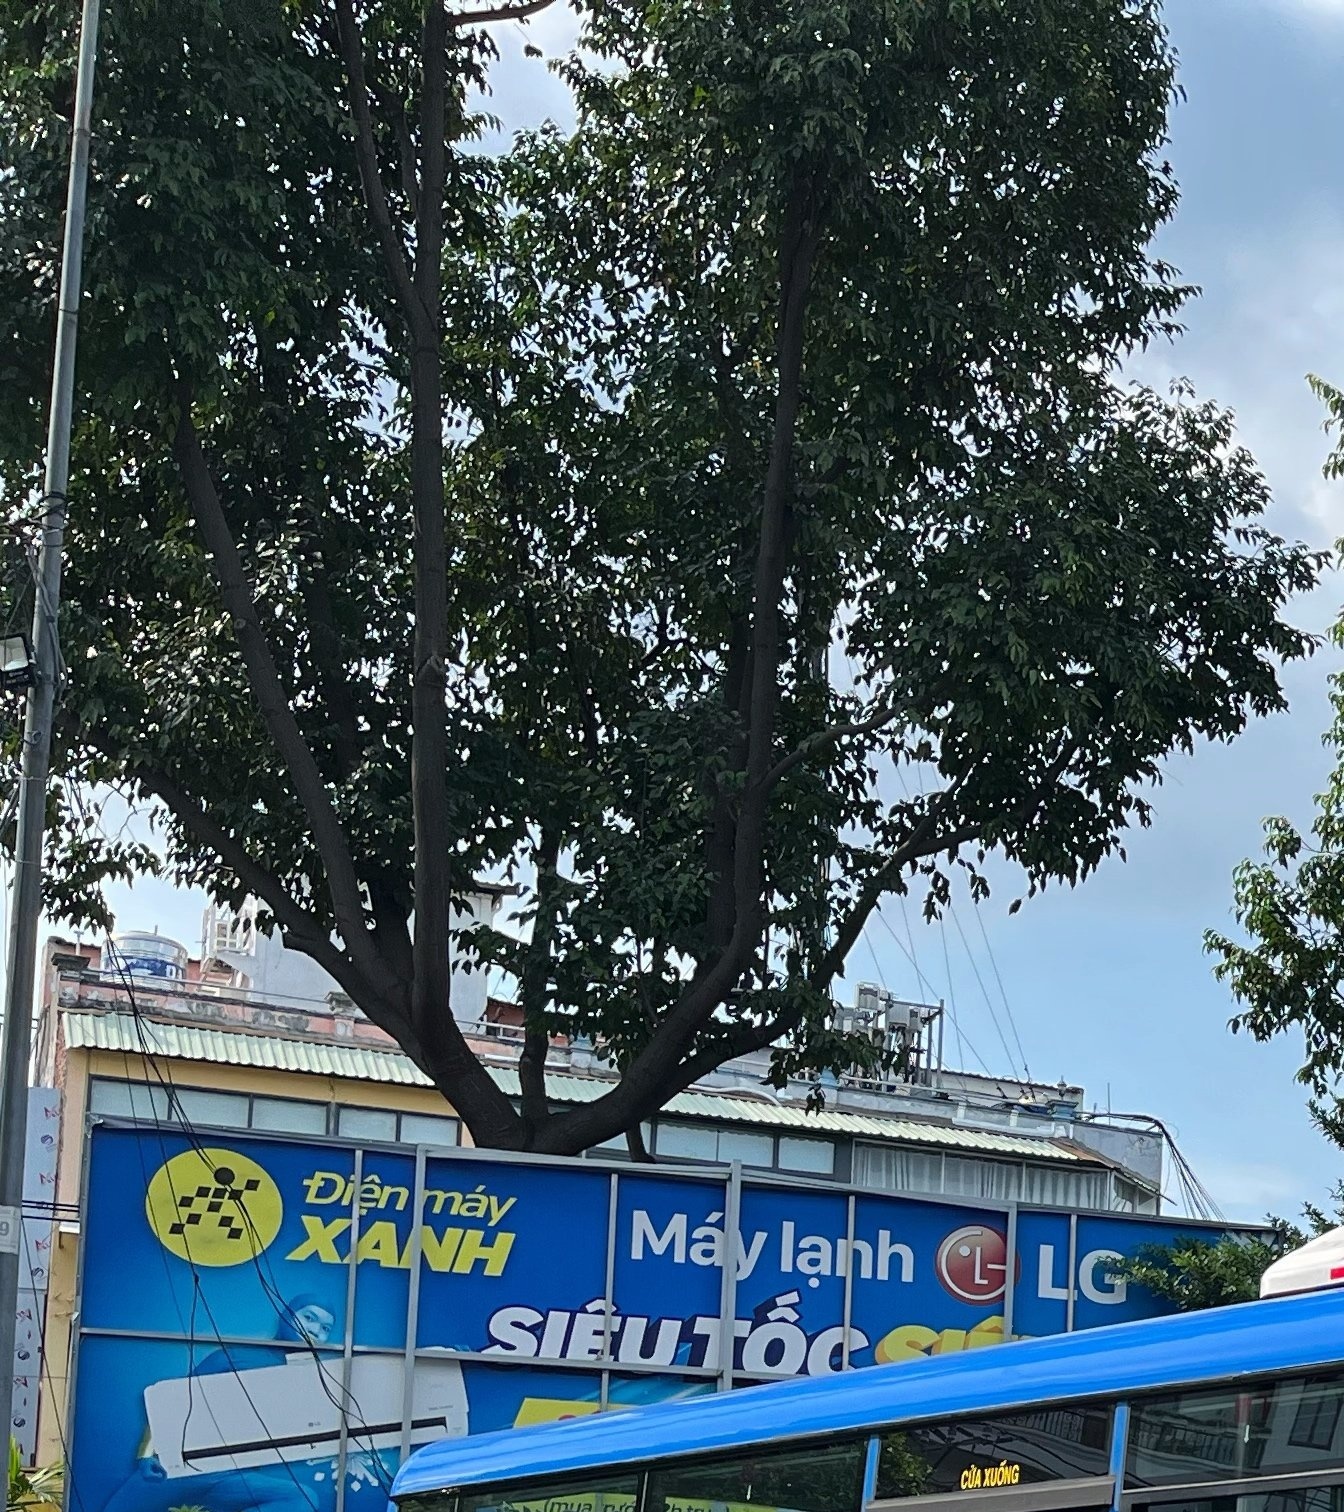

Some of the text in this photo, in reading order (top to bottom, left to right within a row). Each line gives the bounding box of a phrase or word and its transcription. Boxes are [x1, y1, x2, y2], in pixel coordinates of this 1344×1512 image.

[421, 1184, 518, 1227] máy
[284, 1214, 517, 1277] XANH
[630, 1209, 769, 1282] Máy
[780, 1220, 916, 1289] lạnh
[1037, 1244, 1127, 1305] LG
[480, 1298, 683, 1374] SIÊU
[692, 1290, 870, 1377] TỐC
[960, 1459, 1020, 1490] CỬA XUỐNG
